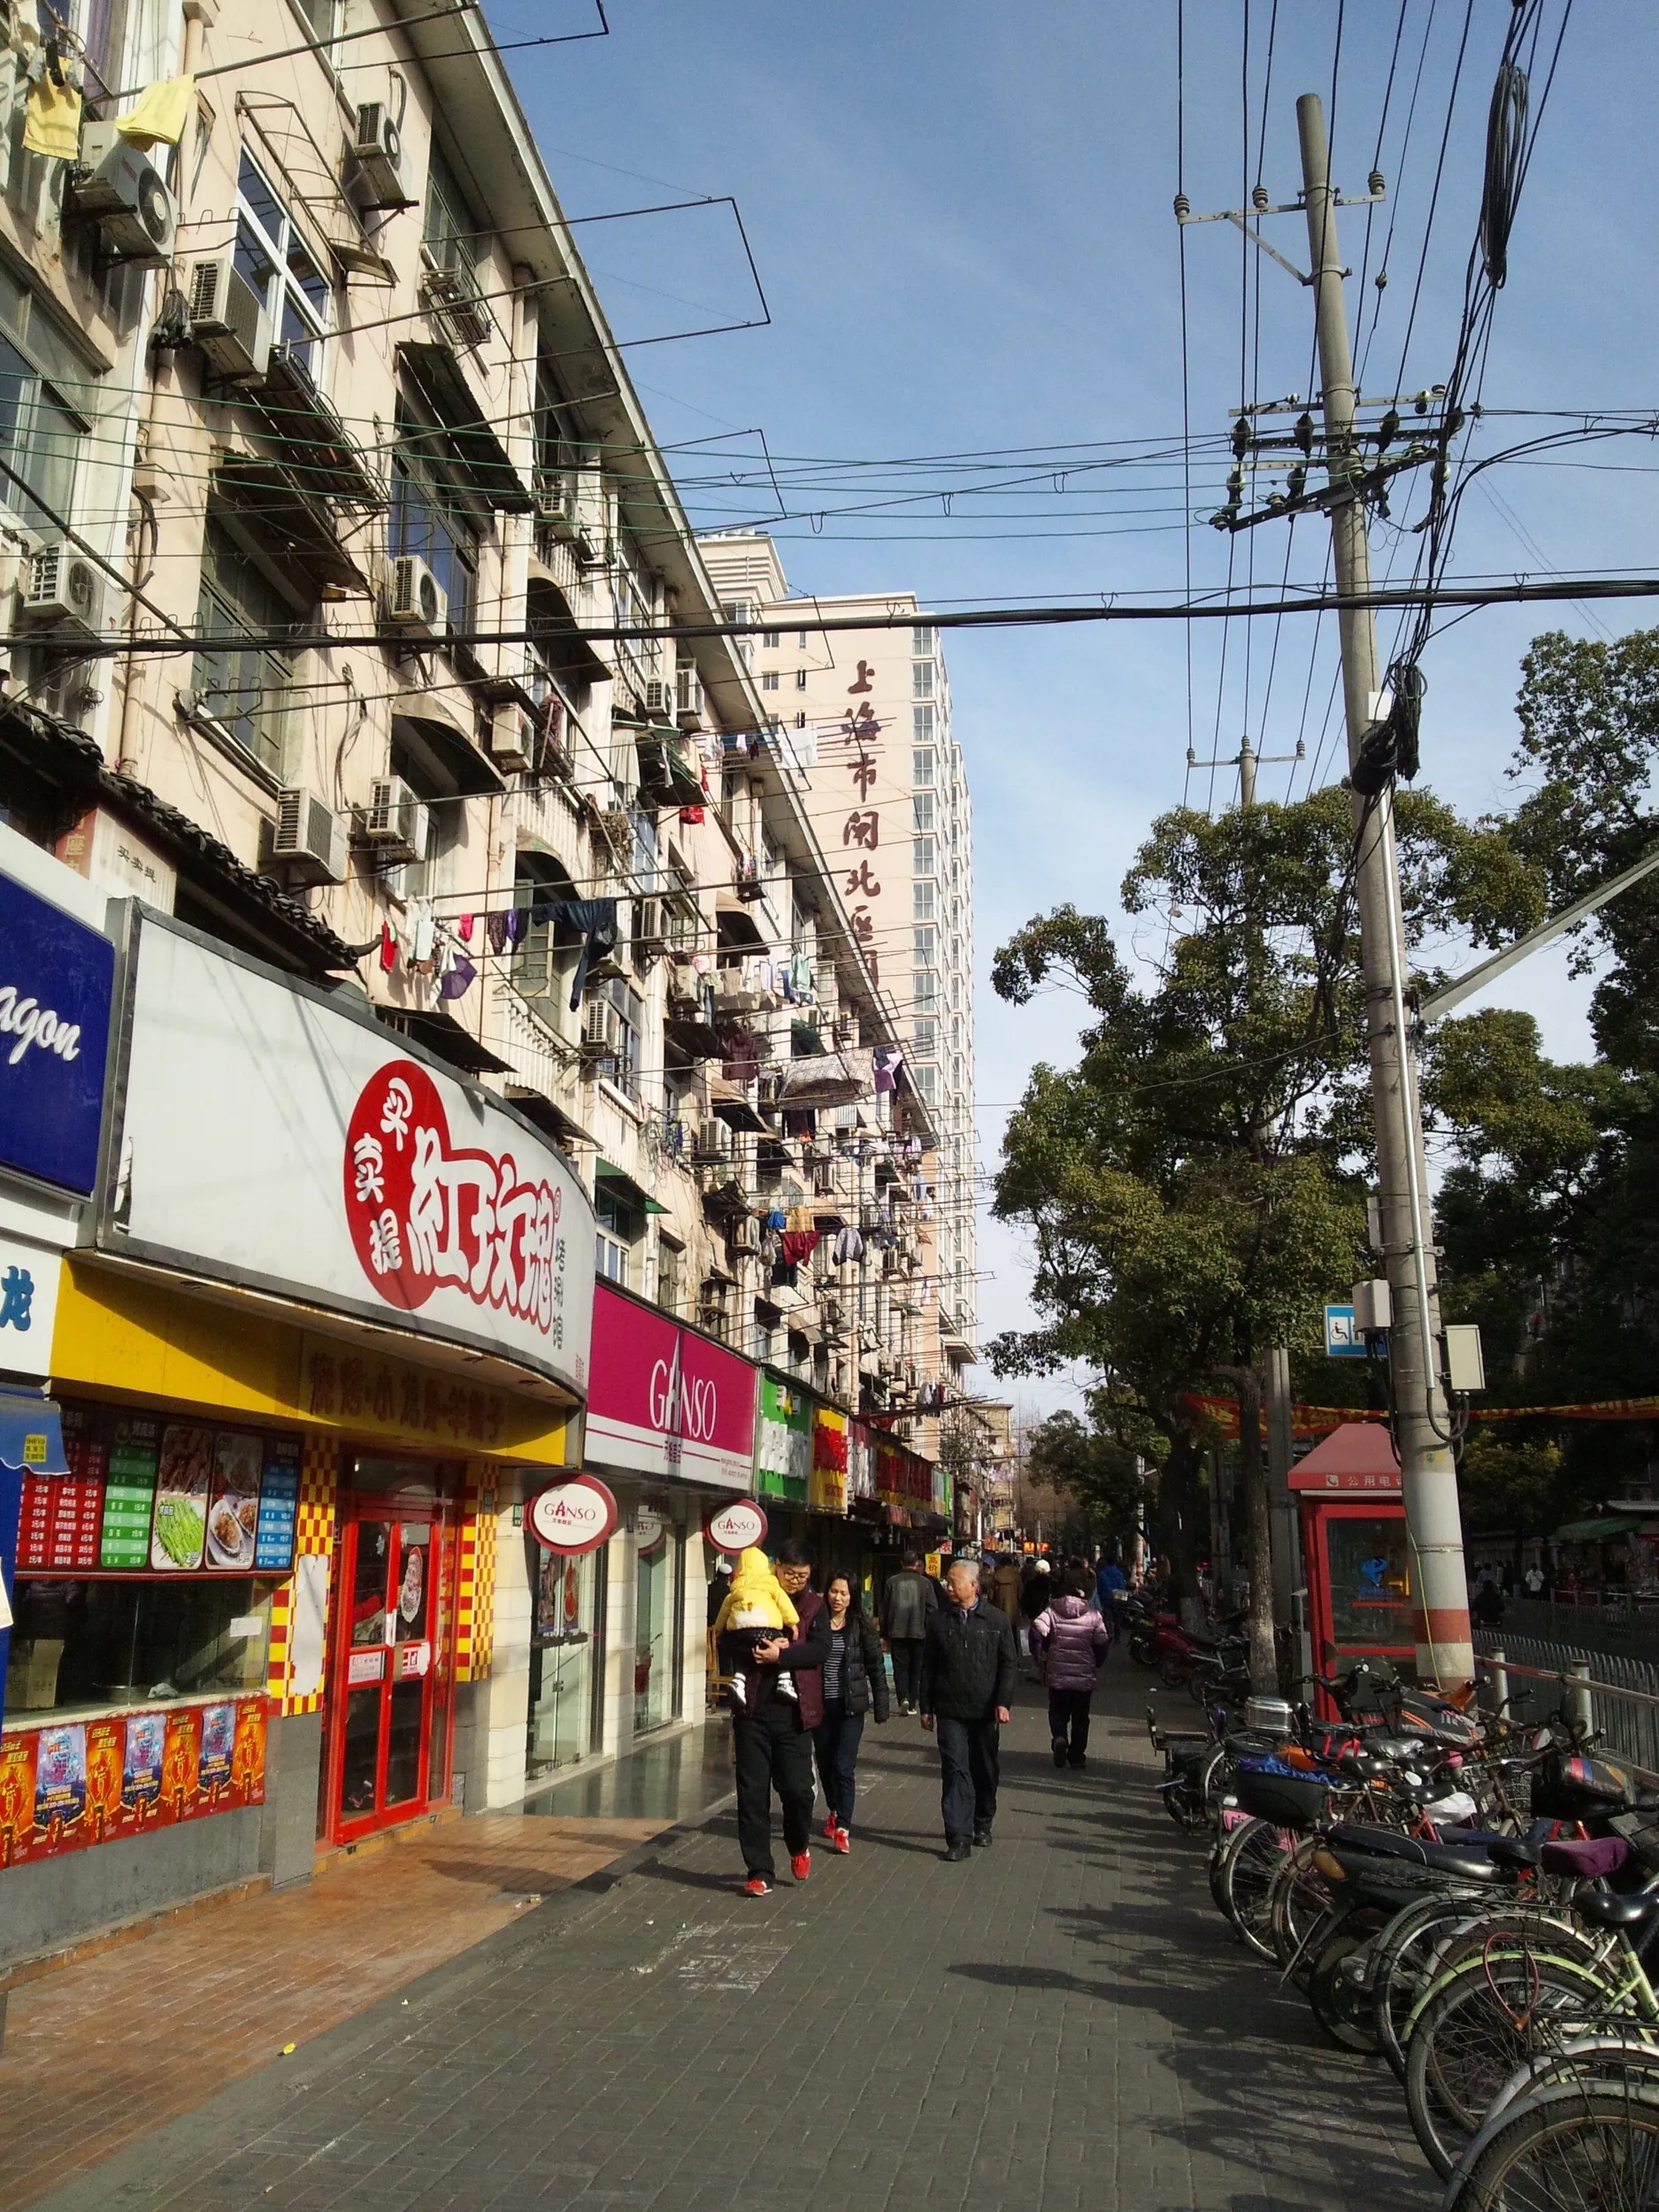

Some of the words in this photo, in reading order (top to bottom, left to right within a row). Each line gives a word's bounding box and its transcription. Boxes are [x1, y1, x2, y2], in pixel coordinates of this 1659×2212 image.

[649, 1331, 717, 1440] GANSO
[543, 1500, 596, 1521] GANSO
[718, 1517, 755, 1530] GANSO
